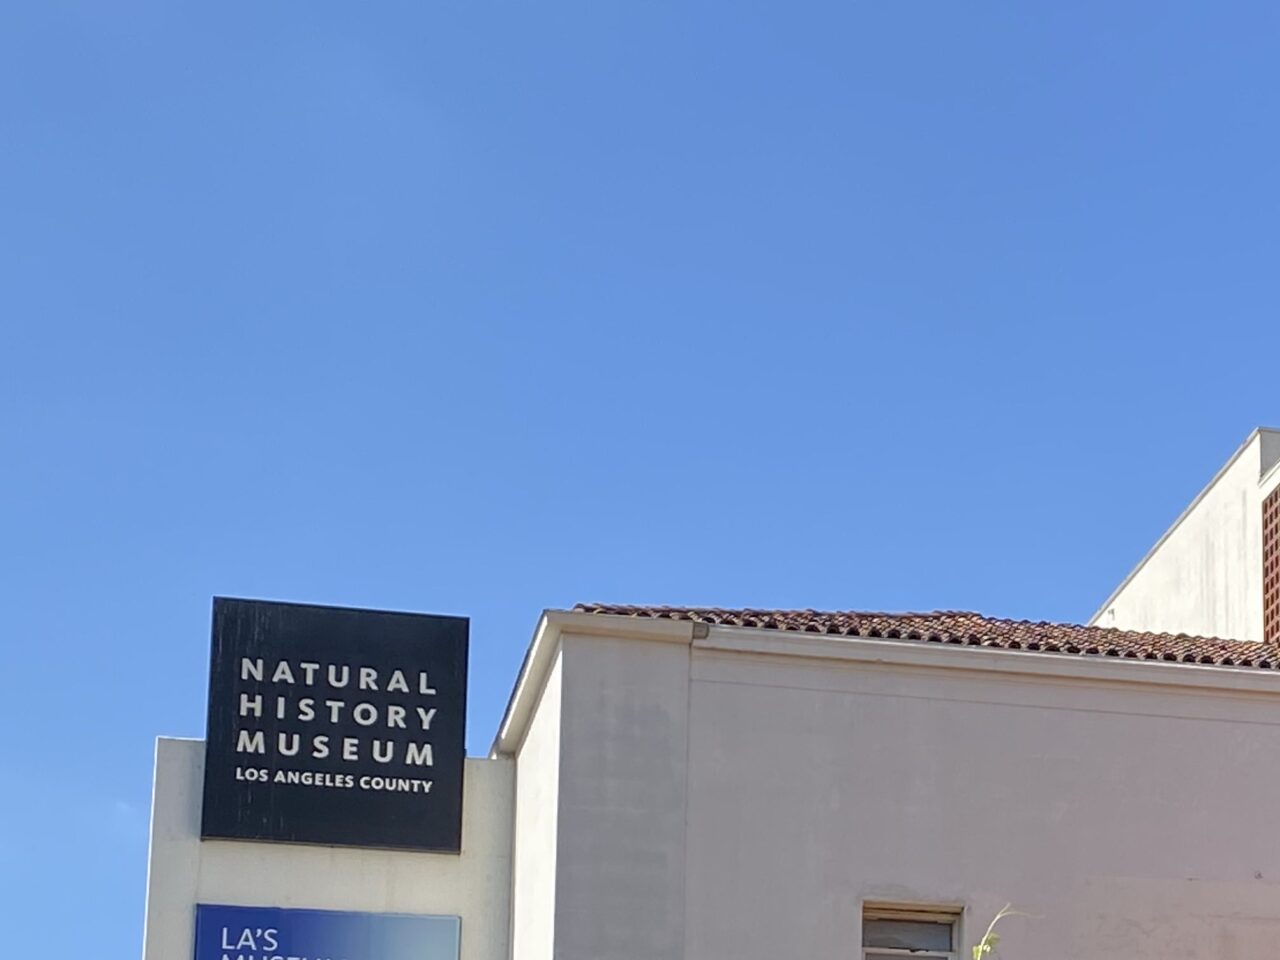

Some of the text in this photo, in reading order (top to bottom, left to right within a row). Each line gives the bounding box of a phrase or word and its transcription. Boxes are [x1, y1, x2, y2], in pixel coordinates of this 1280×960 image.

[240, 657, 437, 695] NATURAL
[239, 694, 437, 730] HISTORY
[236, 730, 434, 766] MUSEUM
[235, 767, 433, 793] LOS ANGELES COUNTY
